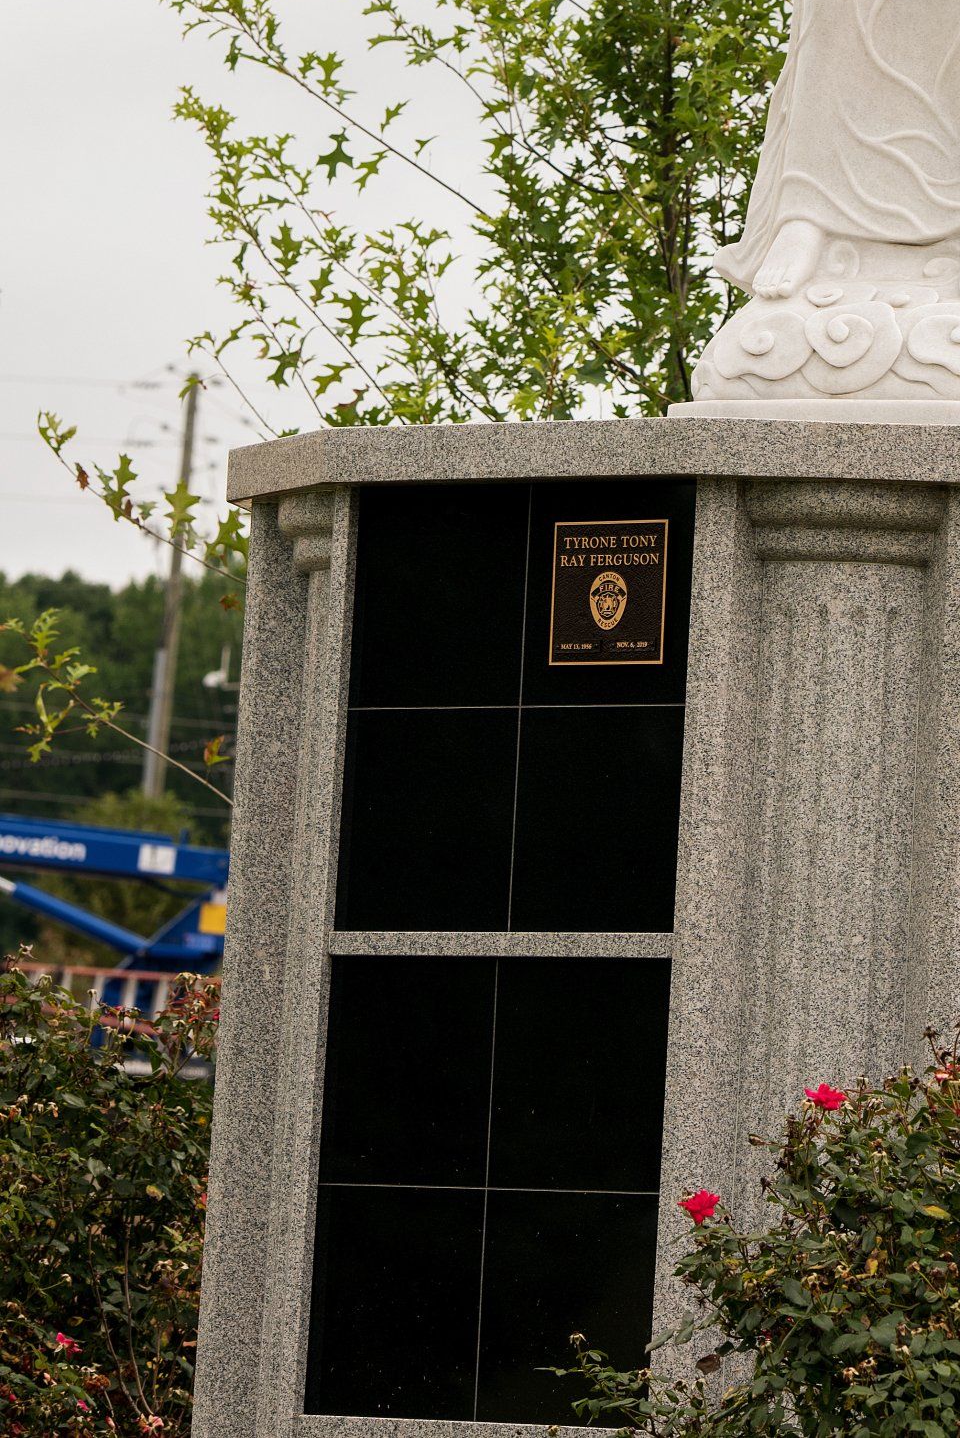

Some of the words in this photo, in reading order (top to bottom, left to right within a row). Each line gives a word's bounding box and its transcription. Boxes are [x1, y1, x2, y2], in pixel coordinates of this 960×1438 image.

[563, 536, 617, 549] TYRONE
[621, 535, 657, 548] TONY
[560, 555, 586, 567] RAY
[590, 554, 659, 566] FERGUSON
[598, 573, 620, 582] CANTON
[599, 584, 620, 593] FIRE
[0, 834, 87, 862] ovation
